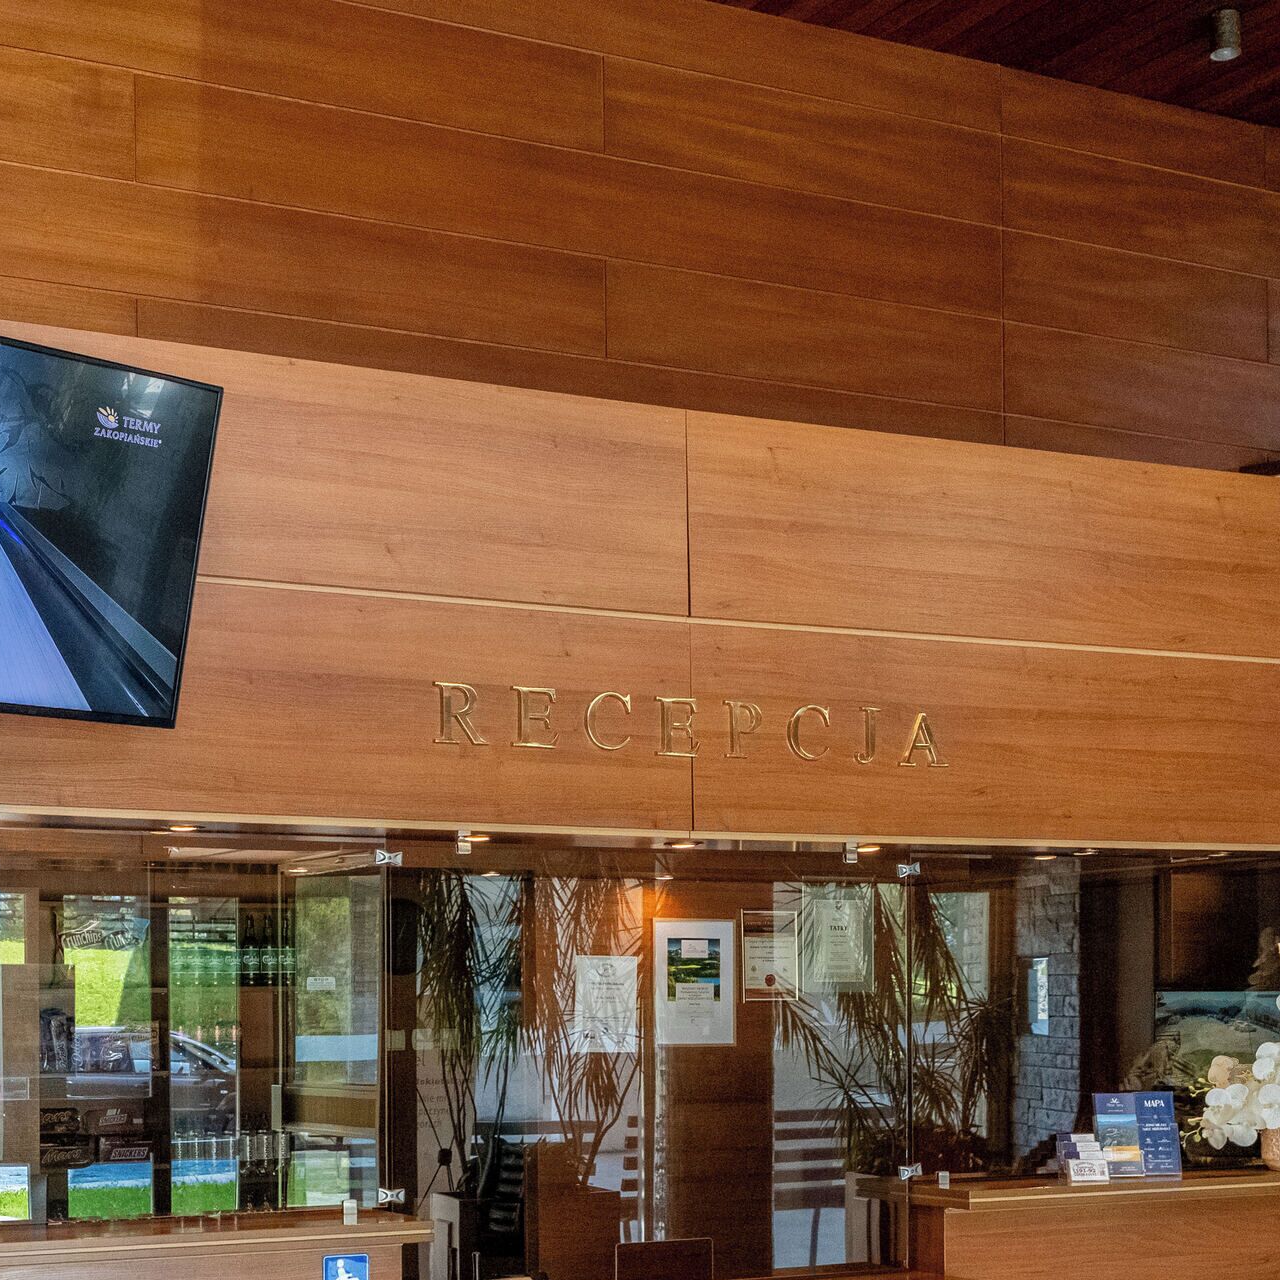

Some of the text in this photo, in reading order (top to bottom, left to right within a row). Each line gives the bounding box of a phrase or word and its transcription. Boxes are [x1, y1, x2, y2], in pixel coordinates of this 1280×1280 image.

[122, 416, 162, 434] TERMY
[433, 681, 949, 767] RECEPCJA
[61, 930, 102, 949] Crunchips
[1144, 1099, 1165, 1108] MAPA
[41, 1148, 81, 1164] Mars
[113, 1149, 147, 1158] SNICKERS
